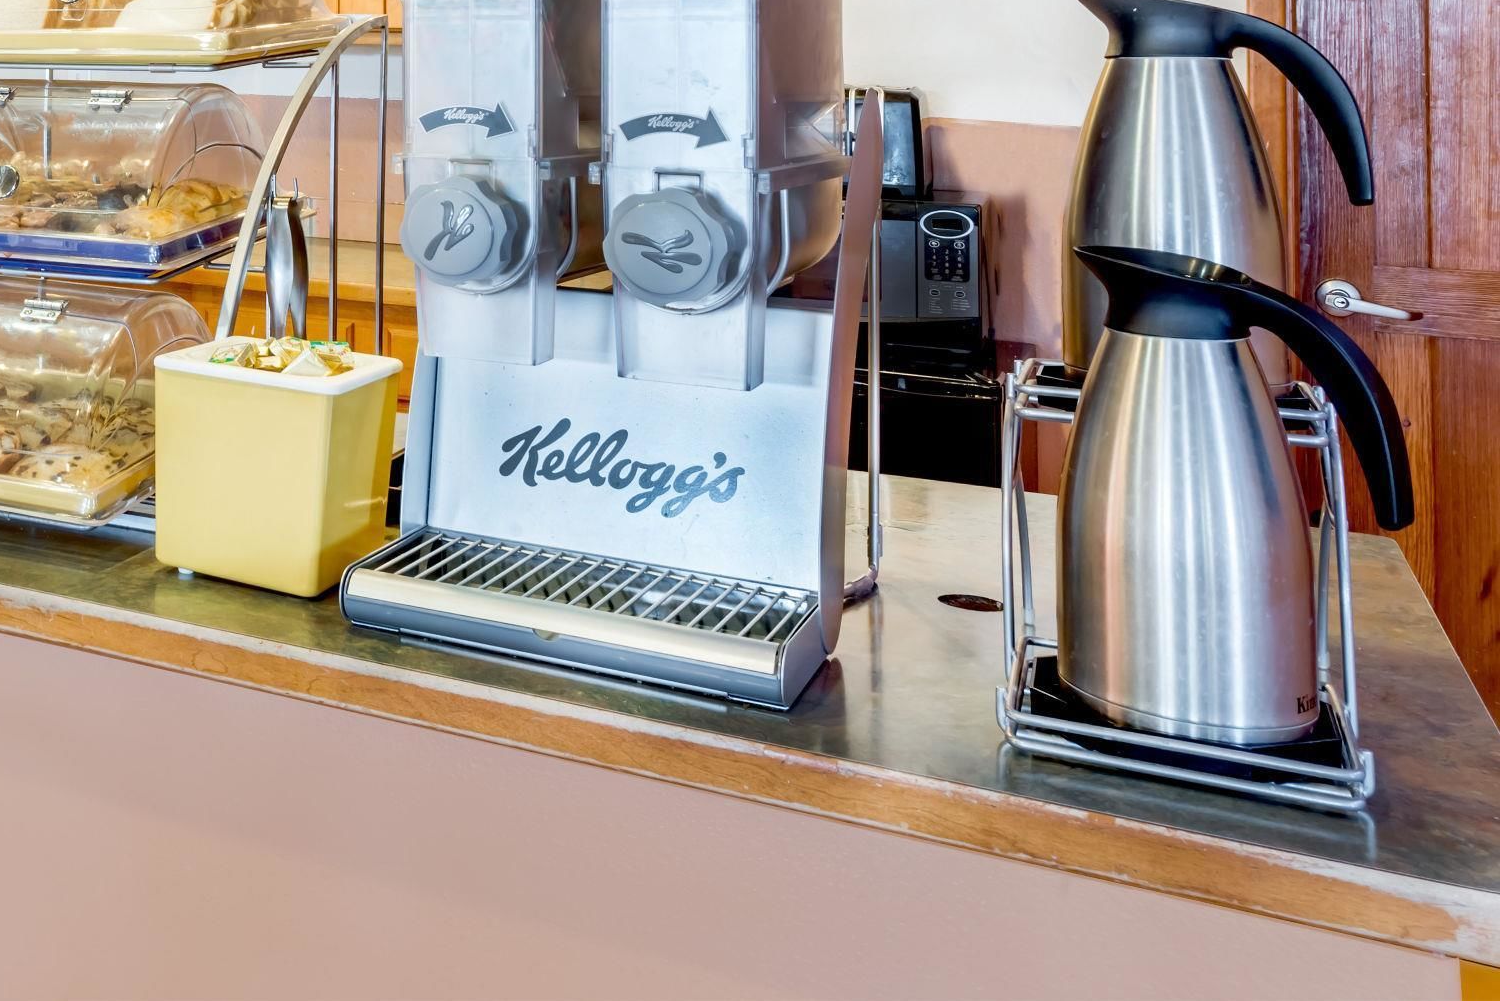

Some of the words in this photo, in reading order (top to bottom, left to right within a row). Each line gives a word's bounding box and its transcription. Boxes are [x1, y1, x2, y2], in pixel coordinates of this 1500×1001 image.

[443, 108, 485, 124] Kellogg's
[648, 115, 695, 132] Kellogg's
[499, 418, 746, 518] Kellogg's
